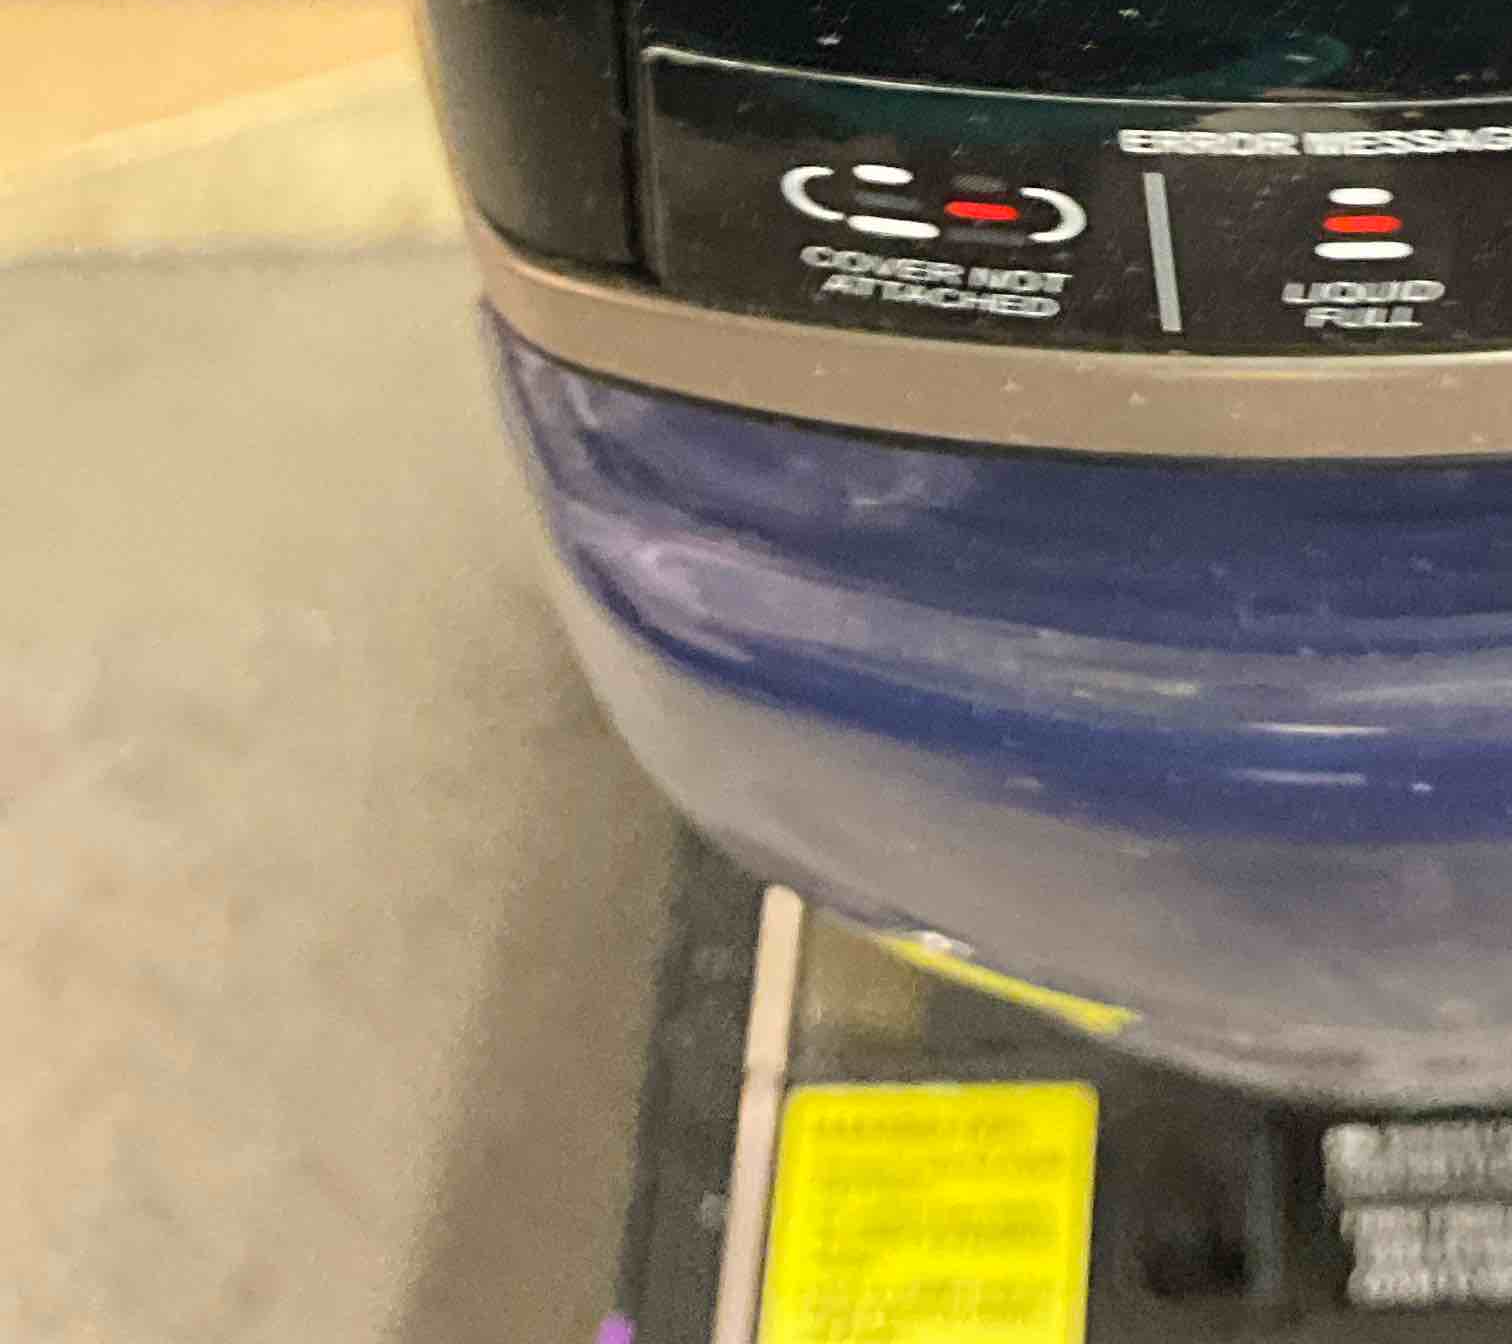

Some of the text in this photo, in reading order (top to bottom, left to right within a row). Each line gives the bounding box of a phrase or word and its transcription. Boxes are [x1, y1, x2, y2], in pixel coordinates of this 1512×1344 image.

[1117, 128, 1301, 156] ERROR
[800, 246, 1074, 293] COVER NOT
[820, 273, 1061, 318] ATTACHED
[1280, 278, 1447, 305] LIQUID
[1303, 306, 1424, 328] FULL
